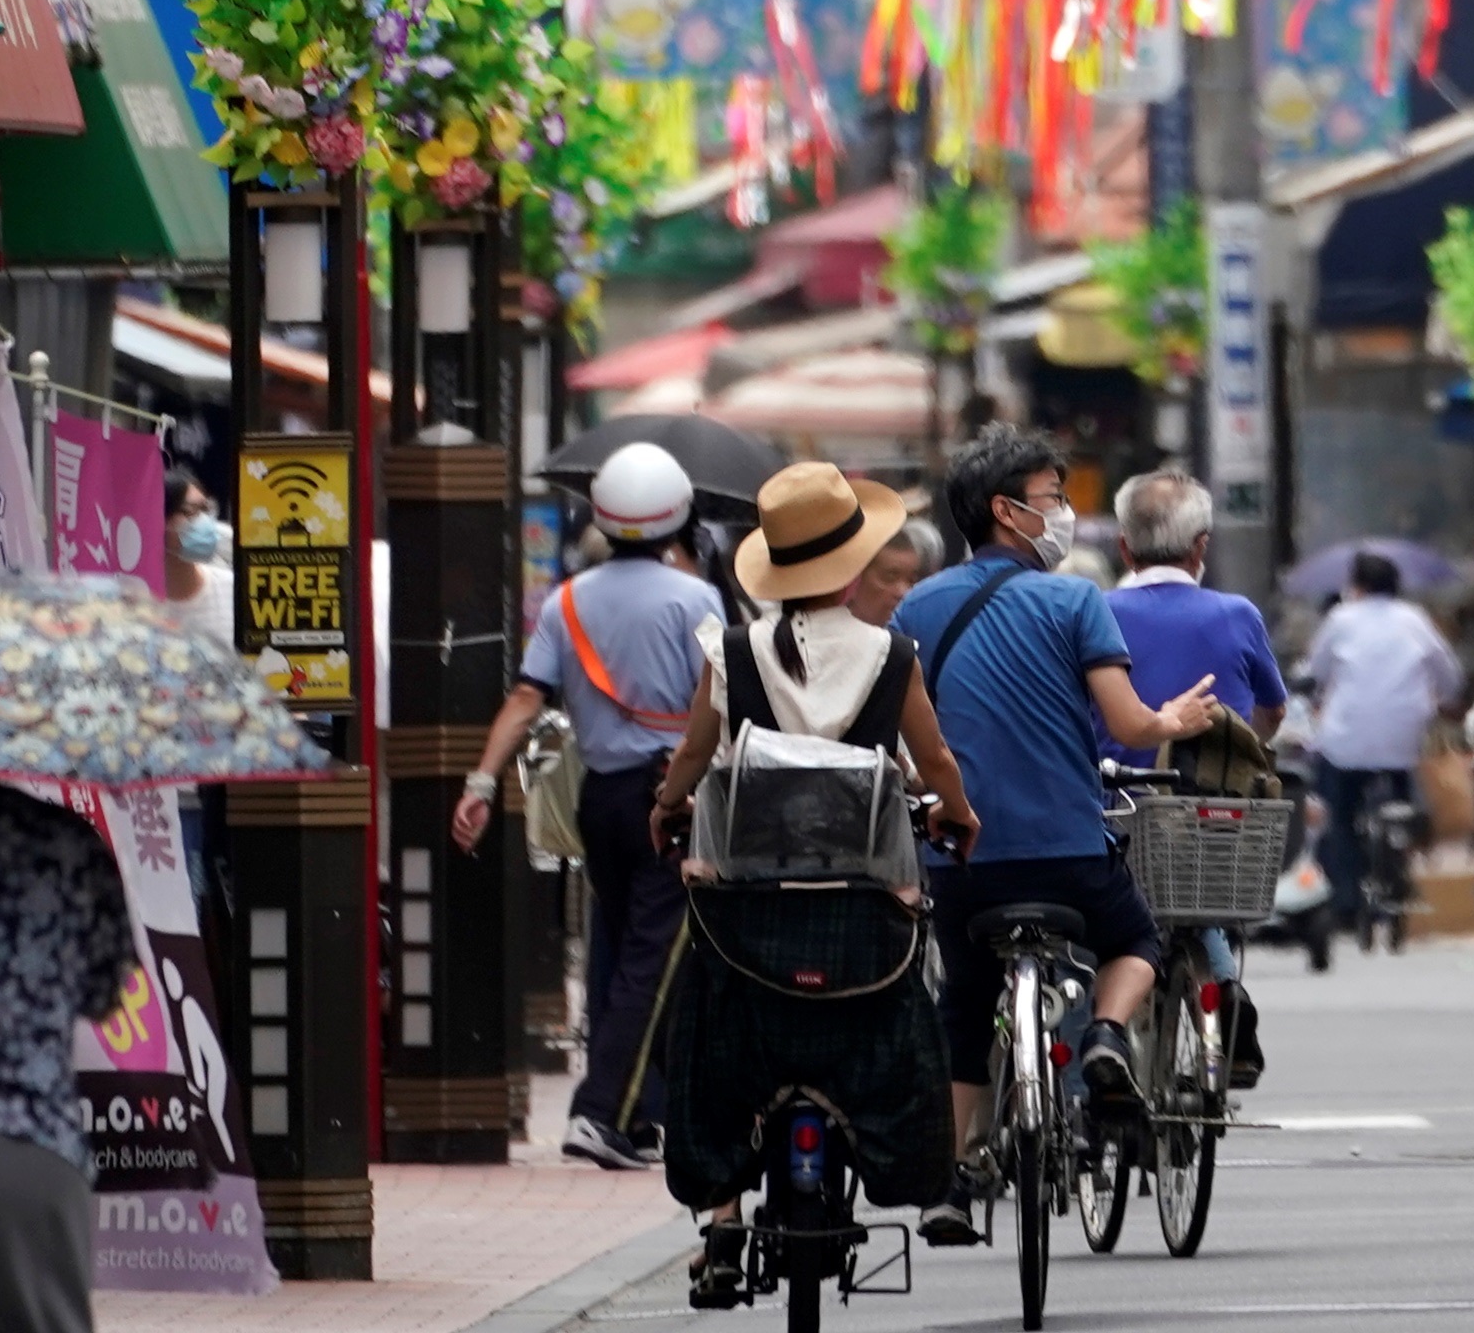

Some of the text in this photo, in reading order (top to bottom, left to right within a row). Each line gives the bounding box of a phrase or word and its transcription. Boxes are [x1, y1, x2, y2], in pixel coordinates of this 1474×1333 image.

[248, 566, 341, 598] FREE
[250, 597, 341, 630] Wi-Fi
[135, 1147, 198, 1171] bodycare
[97, 1246, 171, 1271] stretch
